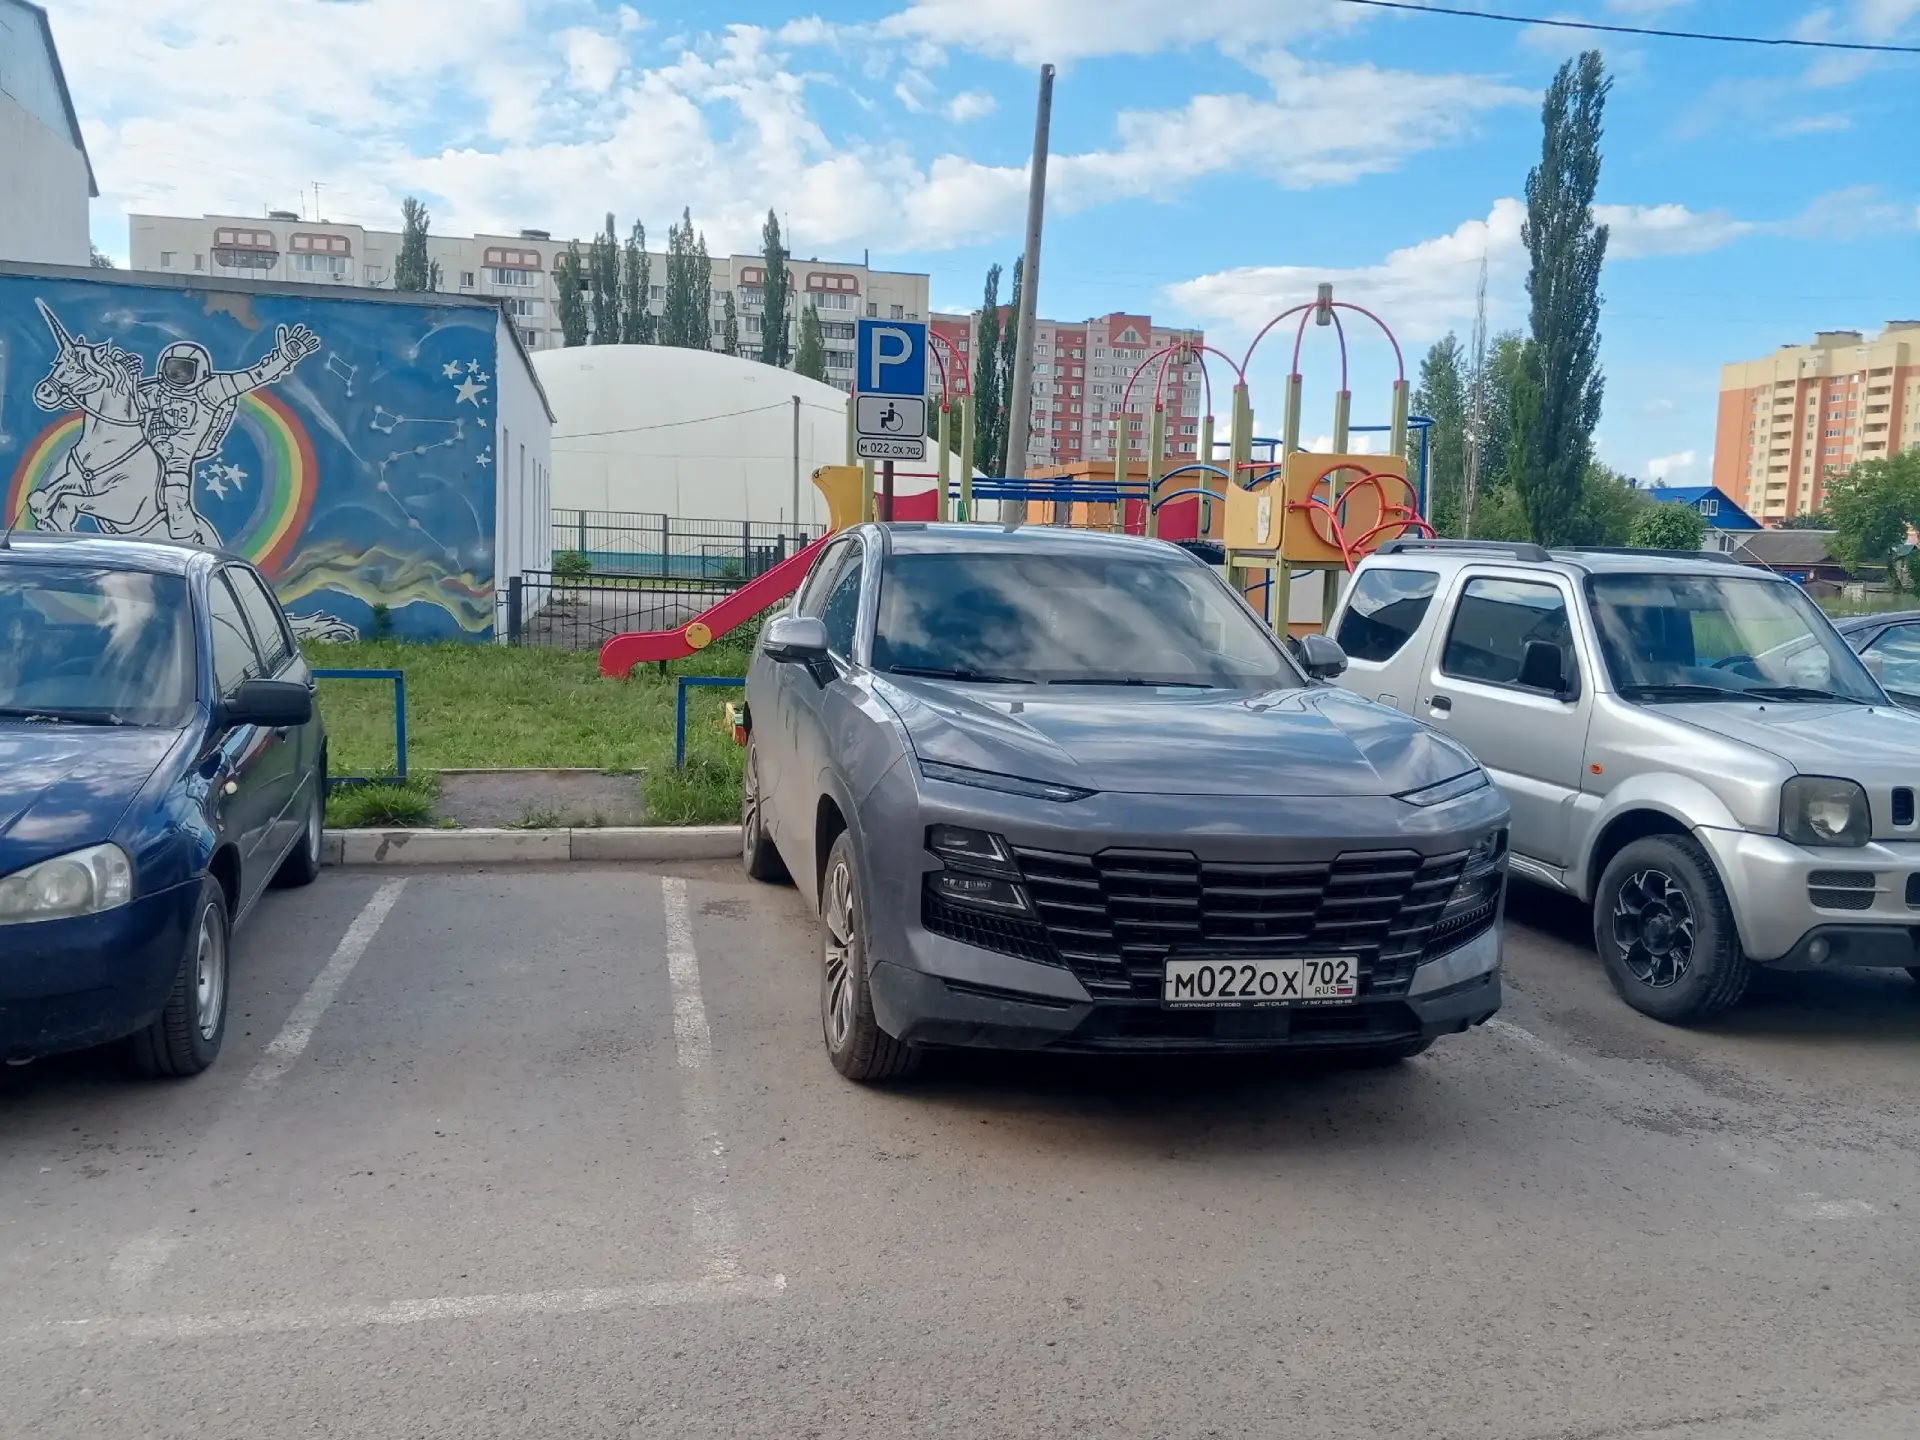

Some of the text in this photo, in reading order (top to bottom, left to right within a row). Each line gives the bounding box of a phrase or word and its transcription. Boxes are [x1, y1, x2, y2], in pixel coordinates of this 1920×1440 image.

[871, 327, 913, 389] P
[860, 442, 921, 455] М 022 ОХ 702
[1175, 961, 1349, 997] М022ОХ 702
[1314, 985, 1337, 995] RUS
